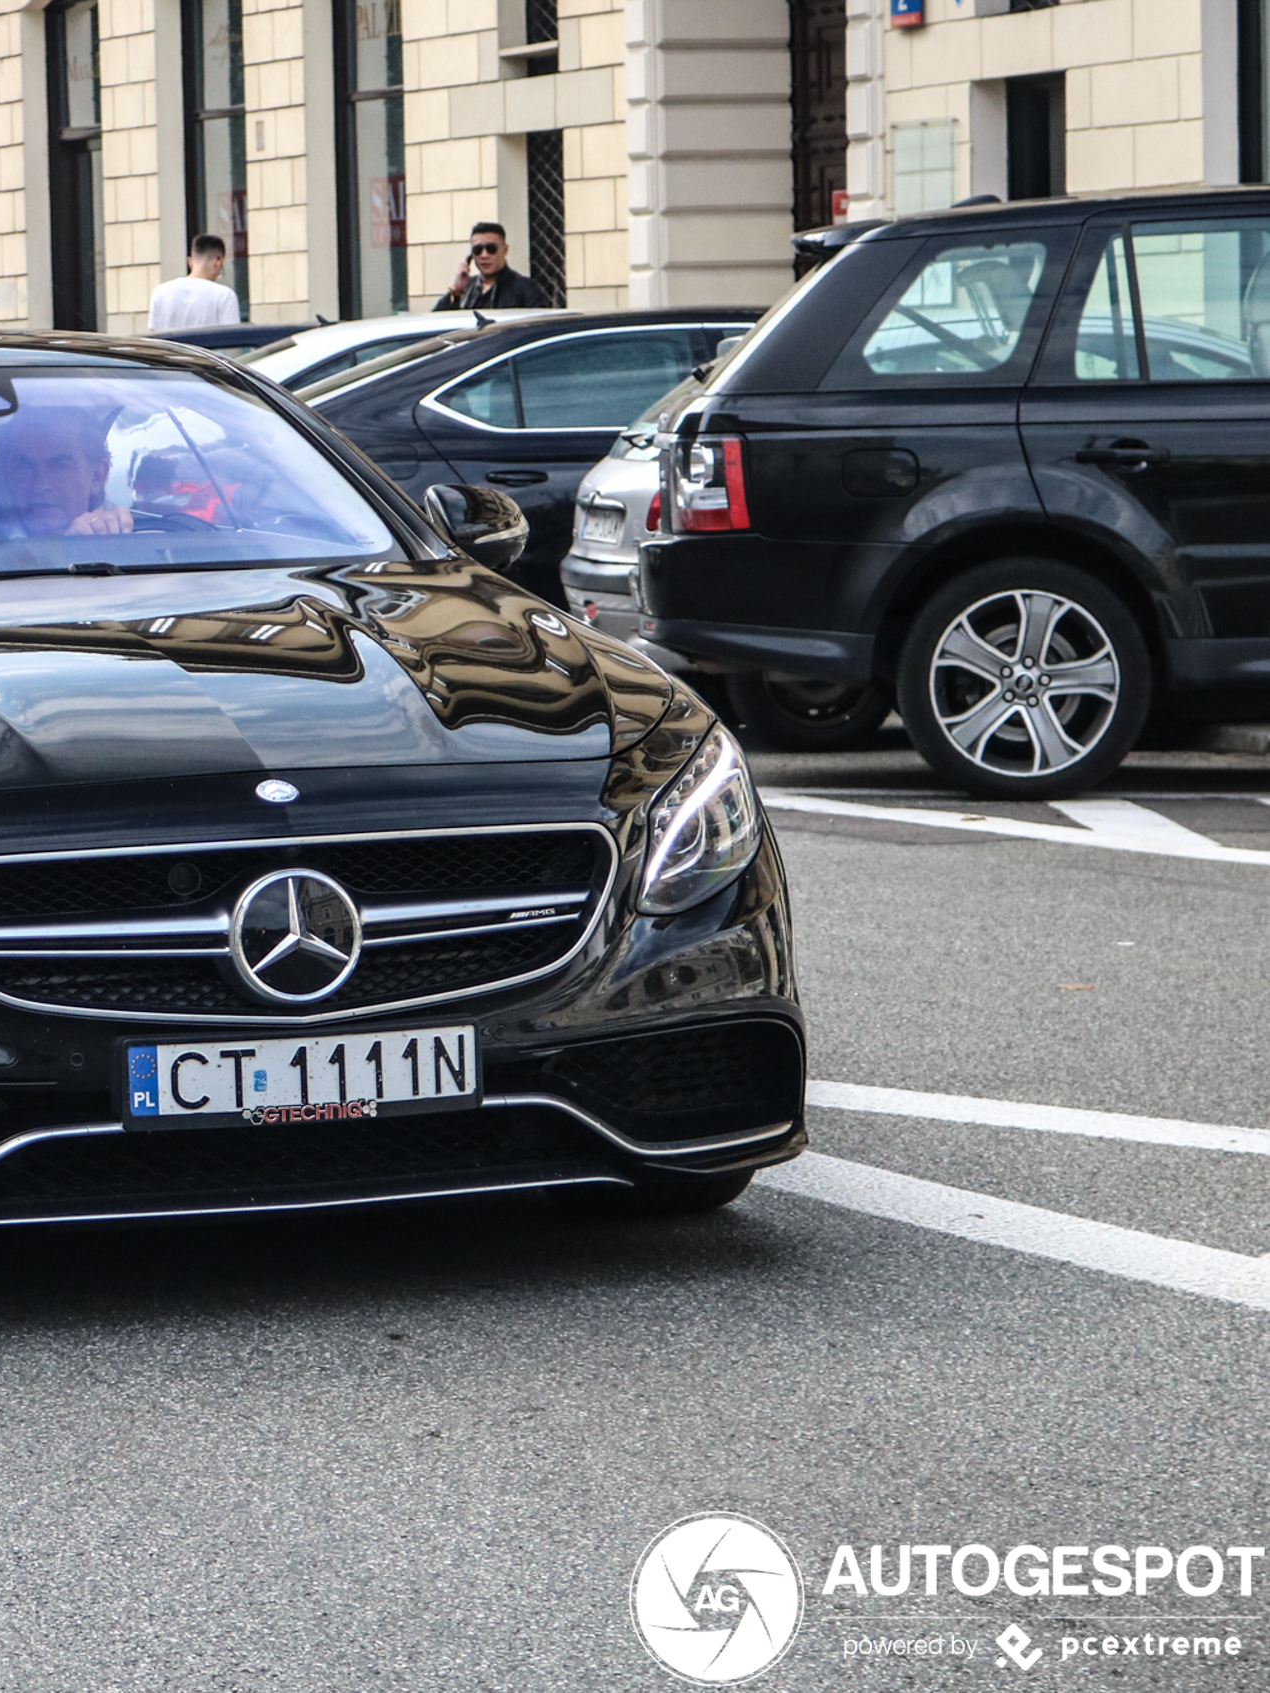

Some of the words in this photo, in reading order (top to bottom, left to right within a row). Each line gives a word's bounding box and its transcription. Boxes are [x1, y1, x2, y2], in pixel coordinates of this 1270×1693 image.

[171, 1048, 256, 1110] CT
[290, 1034, 467, 1105] 1111N
[134, 1091, 156, 1108] PL
[262, 1100, 364, 1123] GTECHNIQ
